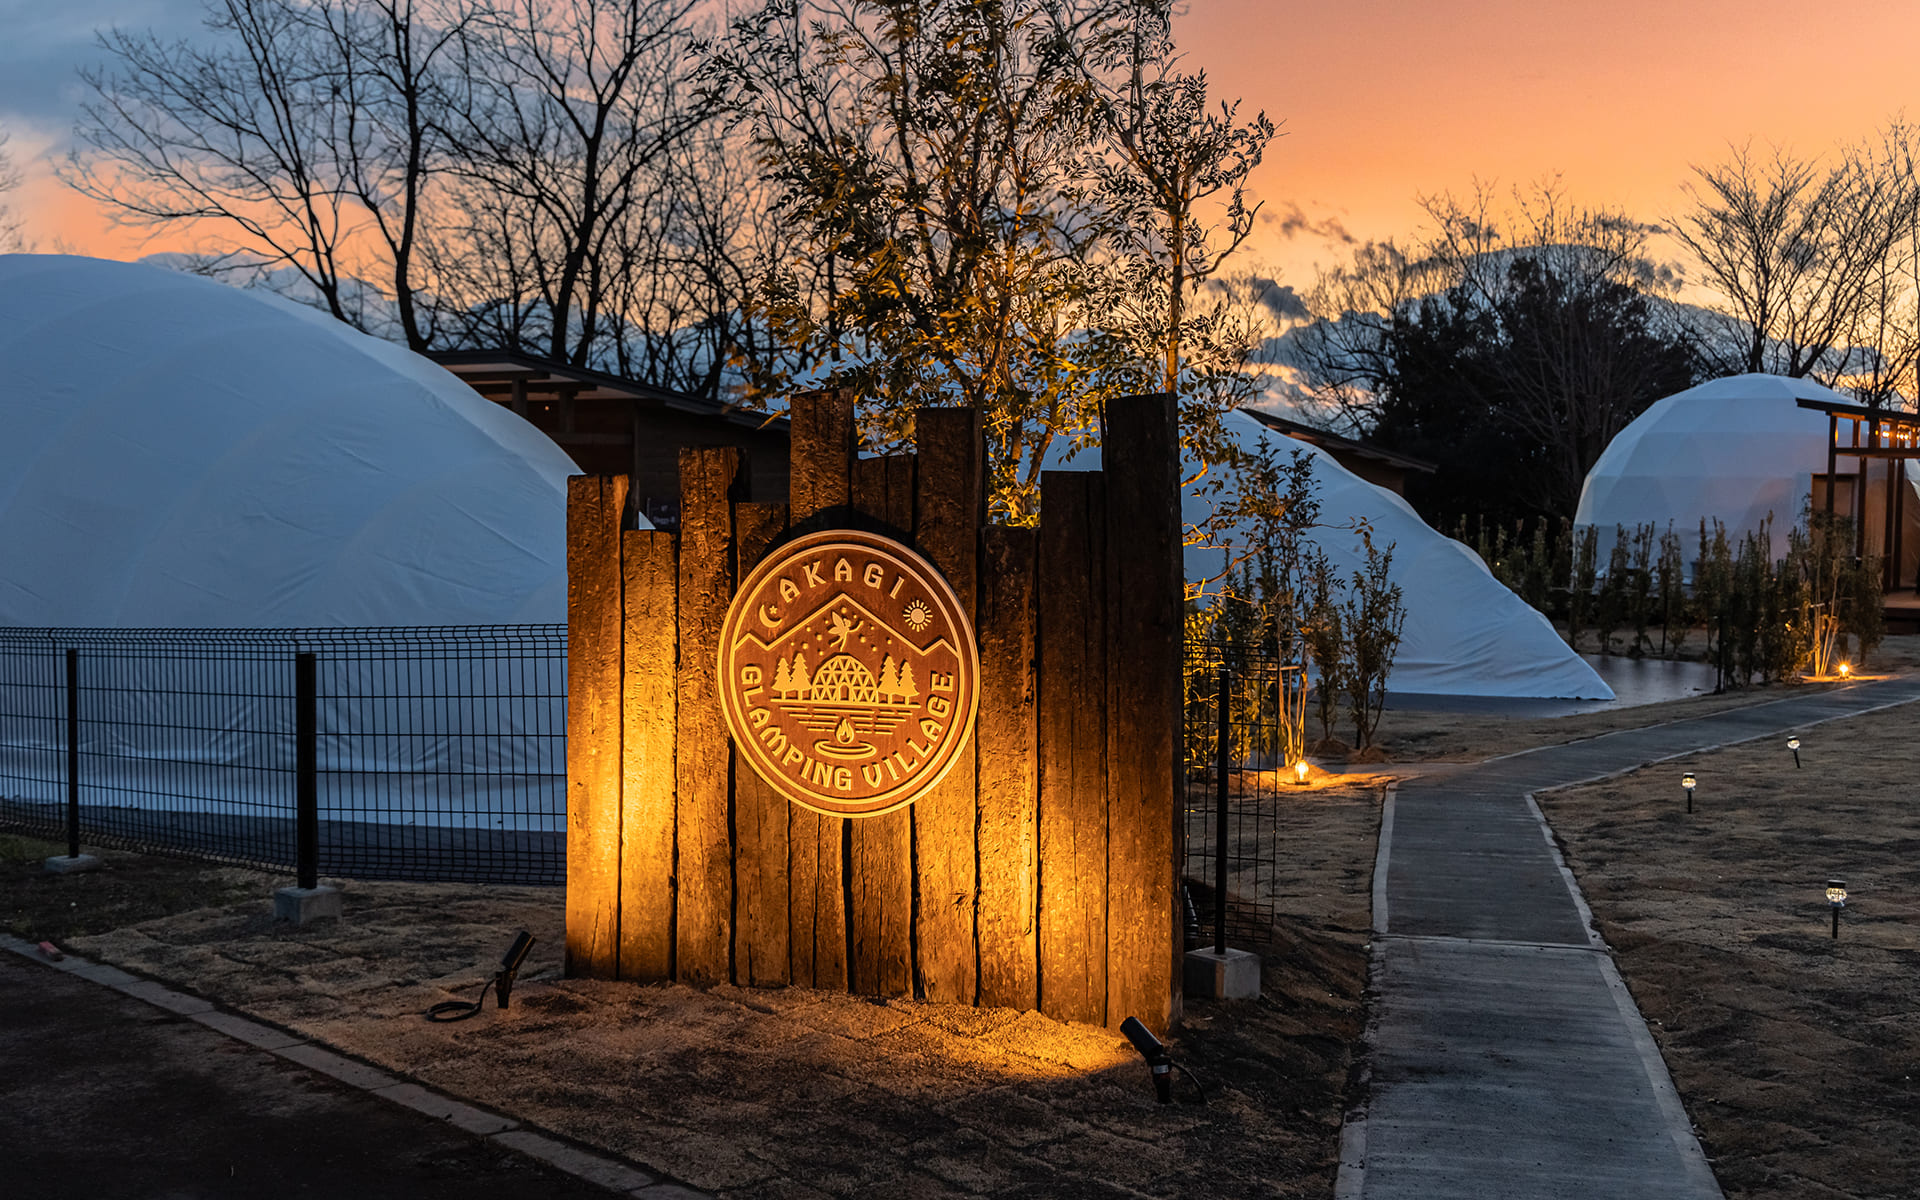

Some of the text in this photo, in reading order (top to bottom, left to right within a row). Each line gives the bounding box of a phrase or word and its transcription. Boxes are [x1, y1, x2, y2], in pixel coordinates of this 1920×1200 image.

[779, 557, 905, 604] AKAGI
[741, 665, 954, 791] GLAMPING VILLAGE
